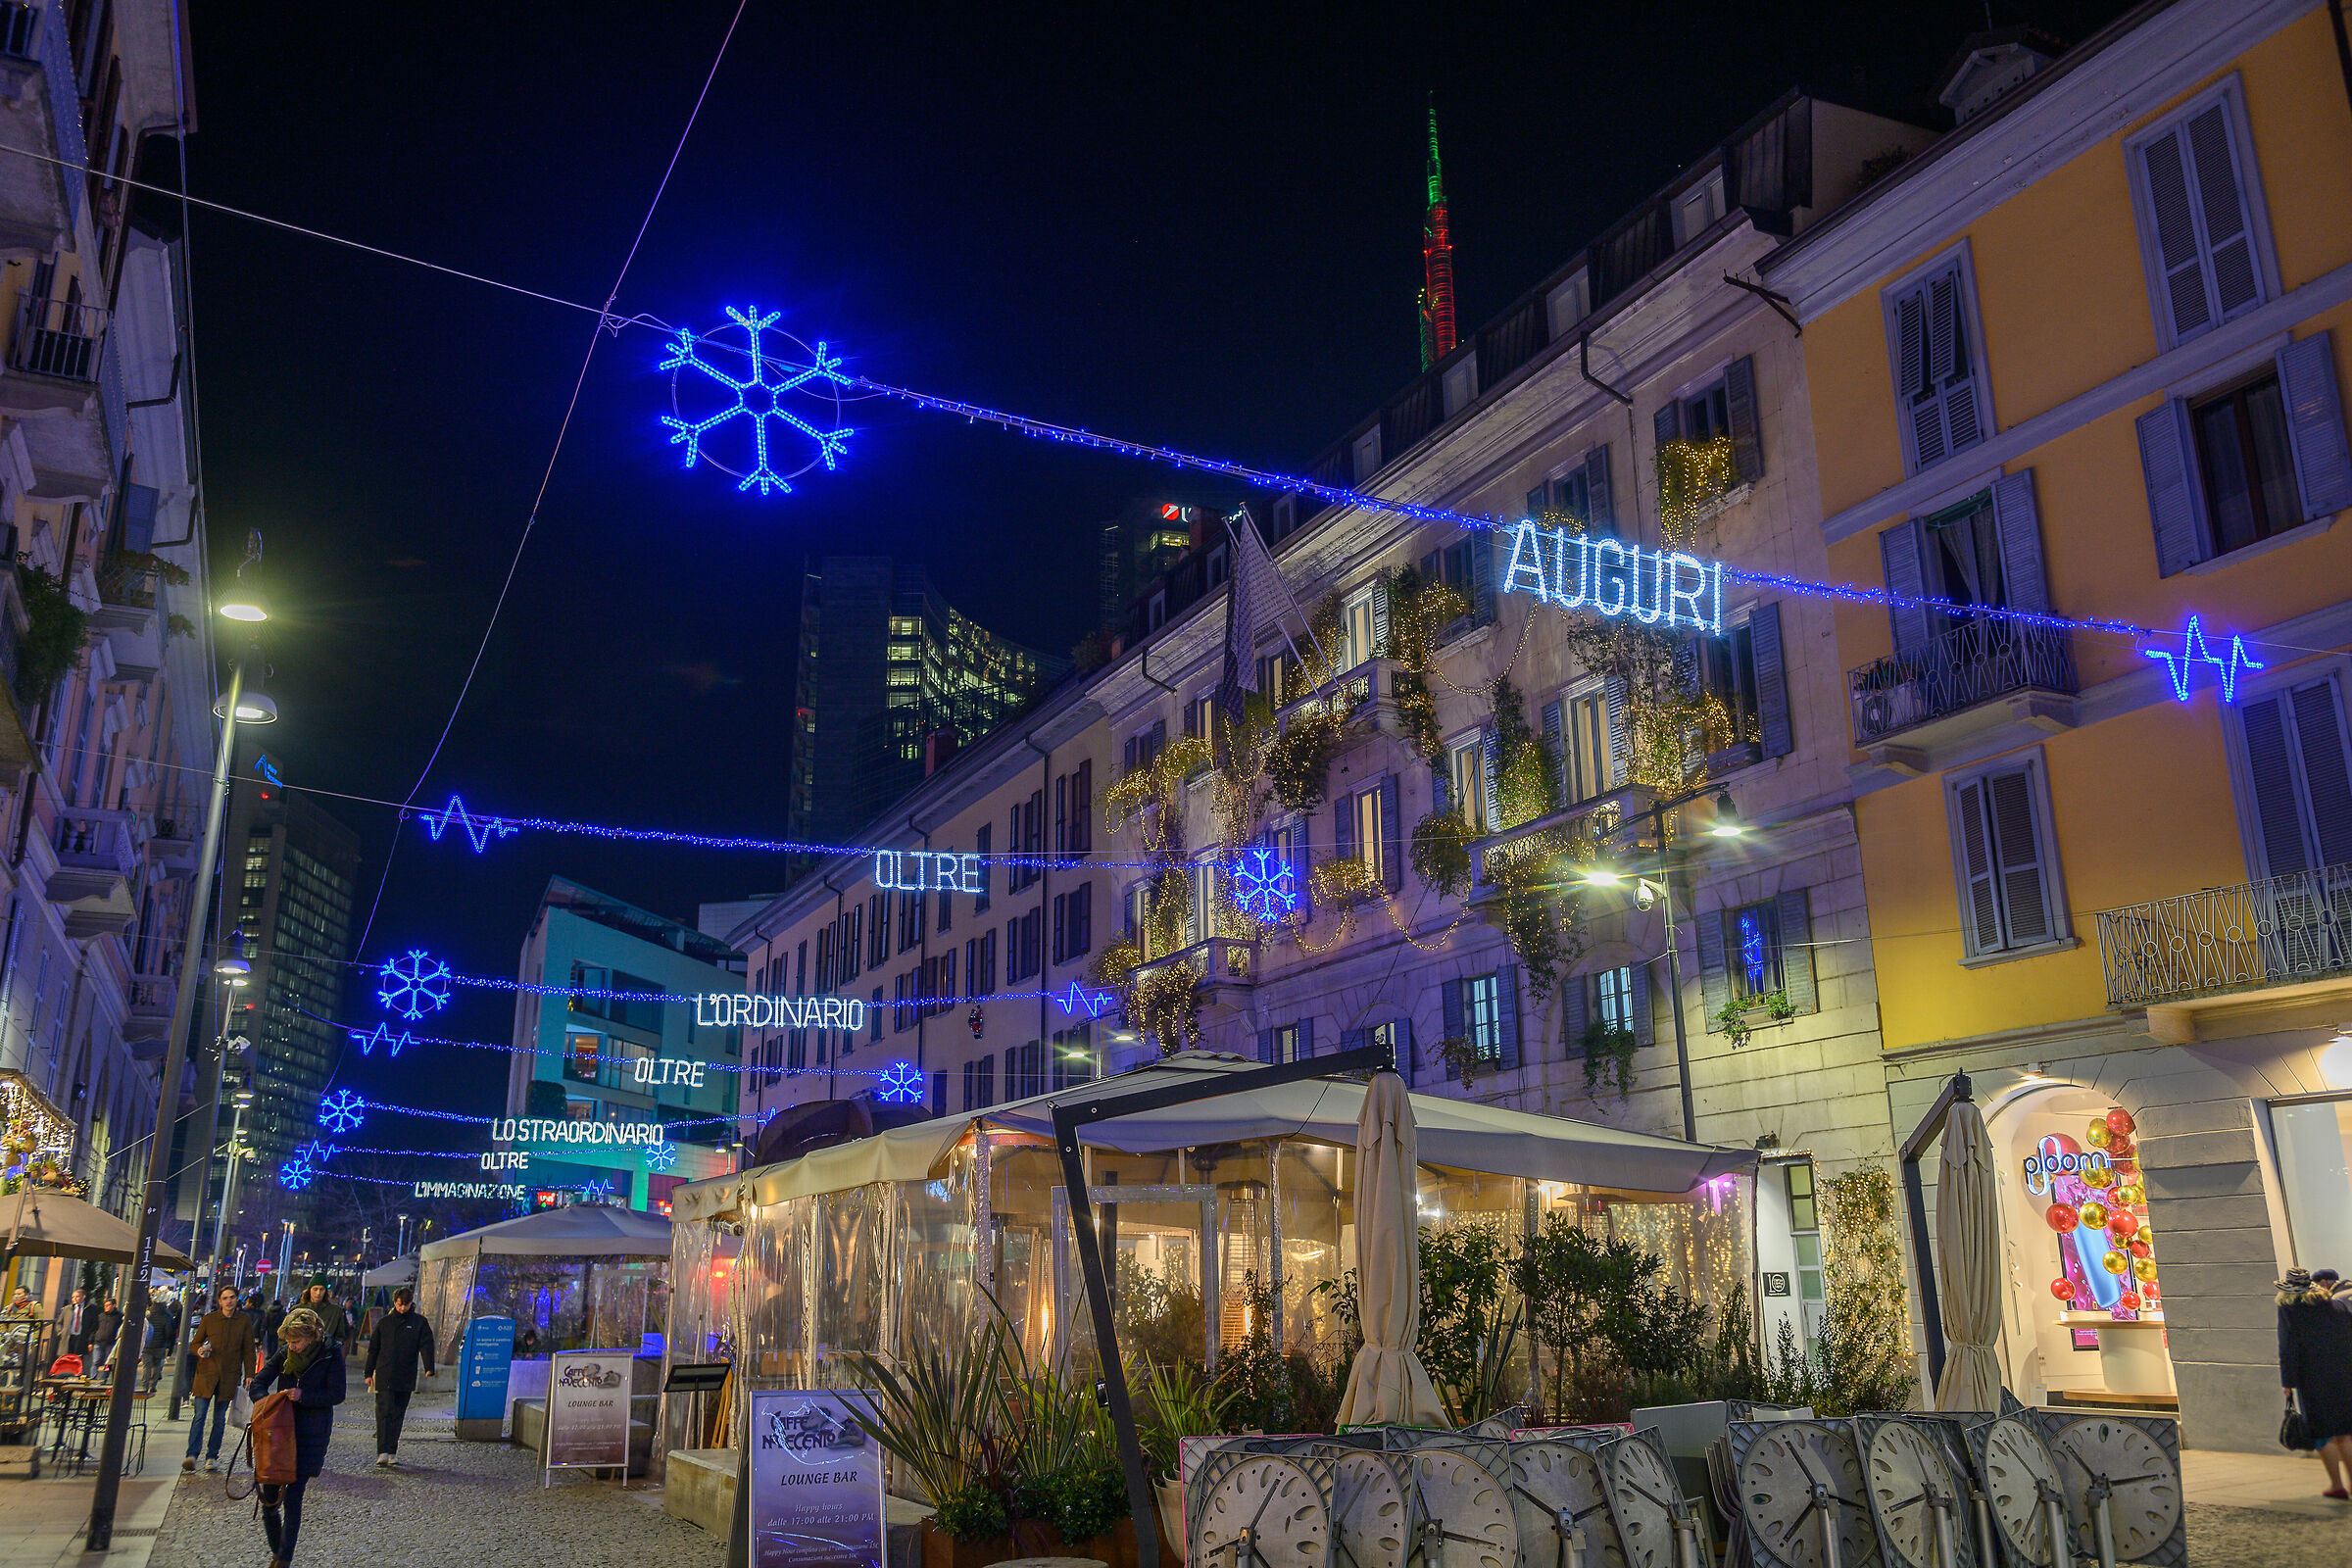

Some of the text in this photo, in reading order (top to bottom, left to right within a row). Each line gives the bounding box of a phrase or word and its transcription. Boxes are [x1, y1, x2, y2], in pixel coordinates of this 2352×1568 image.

[1503, 519, 1723, 637] AUGURI
[874, 849, 982, 893] OLTRE
[696, 992, 864, 1031] L'ORDINARIO
[634, 1056, 707, 1088] OLTRE
[492, 1117, 664, 1146] LO STRAORDINARIO
[481, 1151, 530, 1170] OLTRE
[2024, 1135, 2112, 1197] ploom
[415, 1181, 526, 1200] L'IMMAGINAZONE
[780, 1470, 858, 1487] LOUNGE BAR
[767, 1518, 787, 1527] dalle
[791, 1516, 815, 1526] 17:00
[835, 1514, 859, 1523] 21:00
[795, 1504, 820, 1513] Happy
